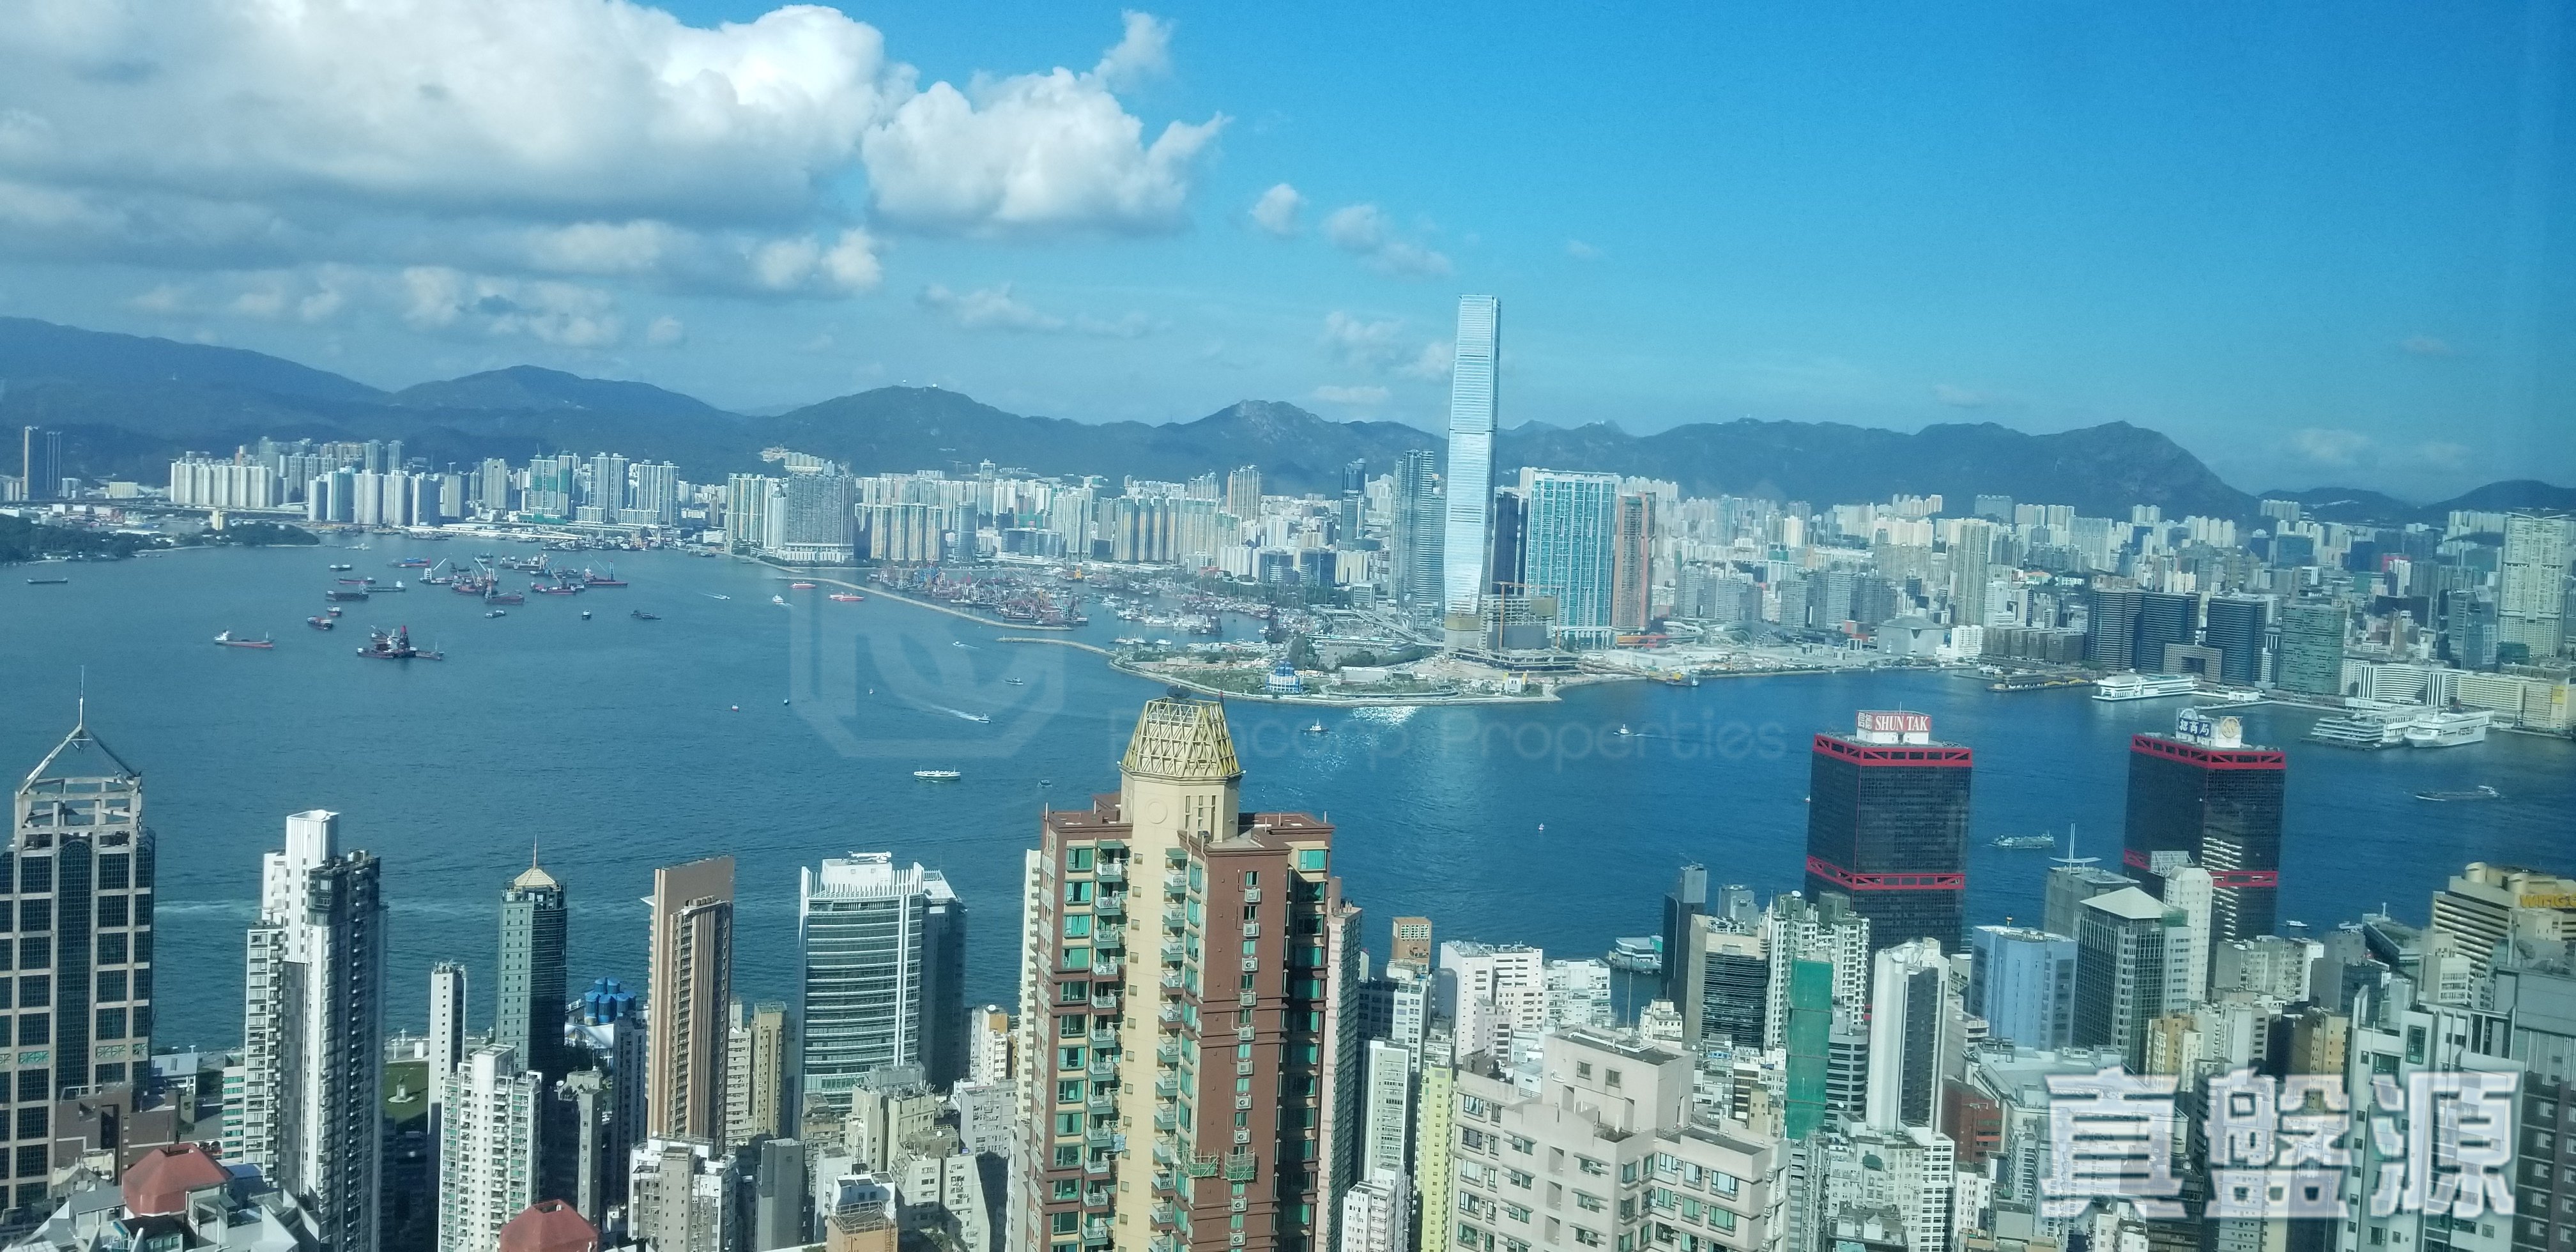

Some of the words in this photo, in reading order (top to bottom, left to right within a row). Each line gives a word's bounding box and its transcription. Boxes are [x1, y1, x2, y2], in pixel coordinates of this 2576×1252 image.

[1875, 715, 1904, 730] SHUN
[1906, 716, 1928, 731] TAK
[2179, 719, 2210, 736] 招商局
